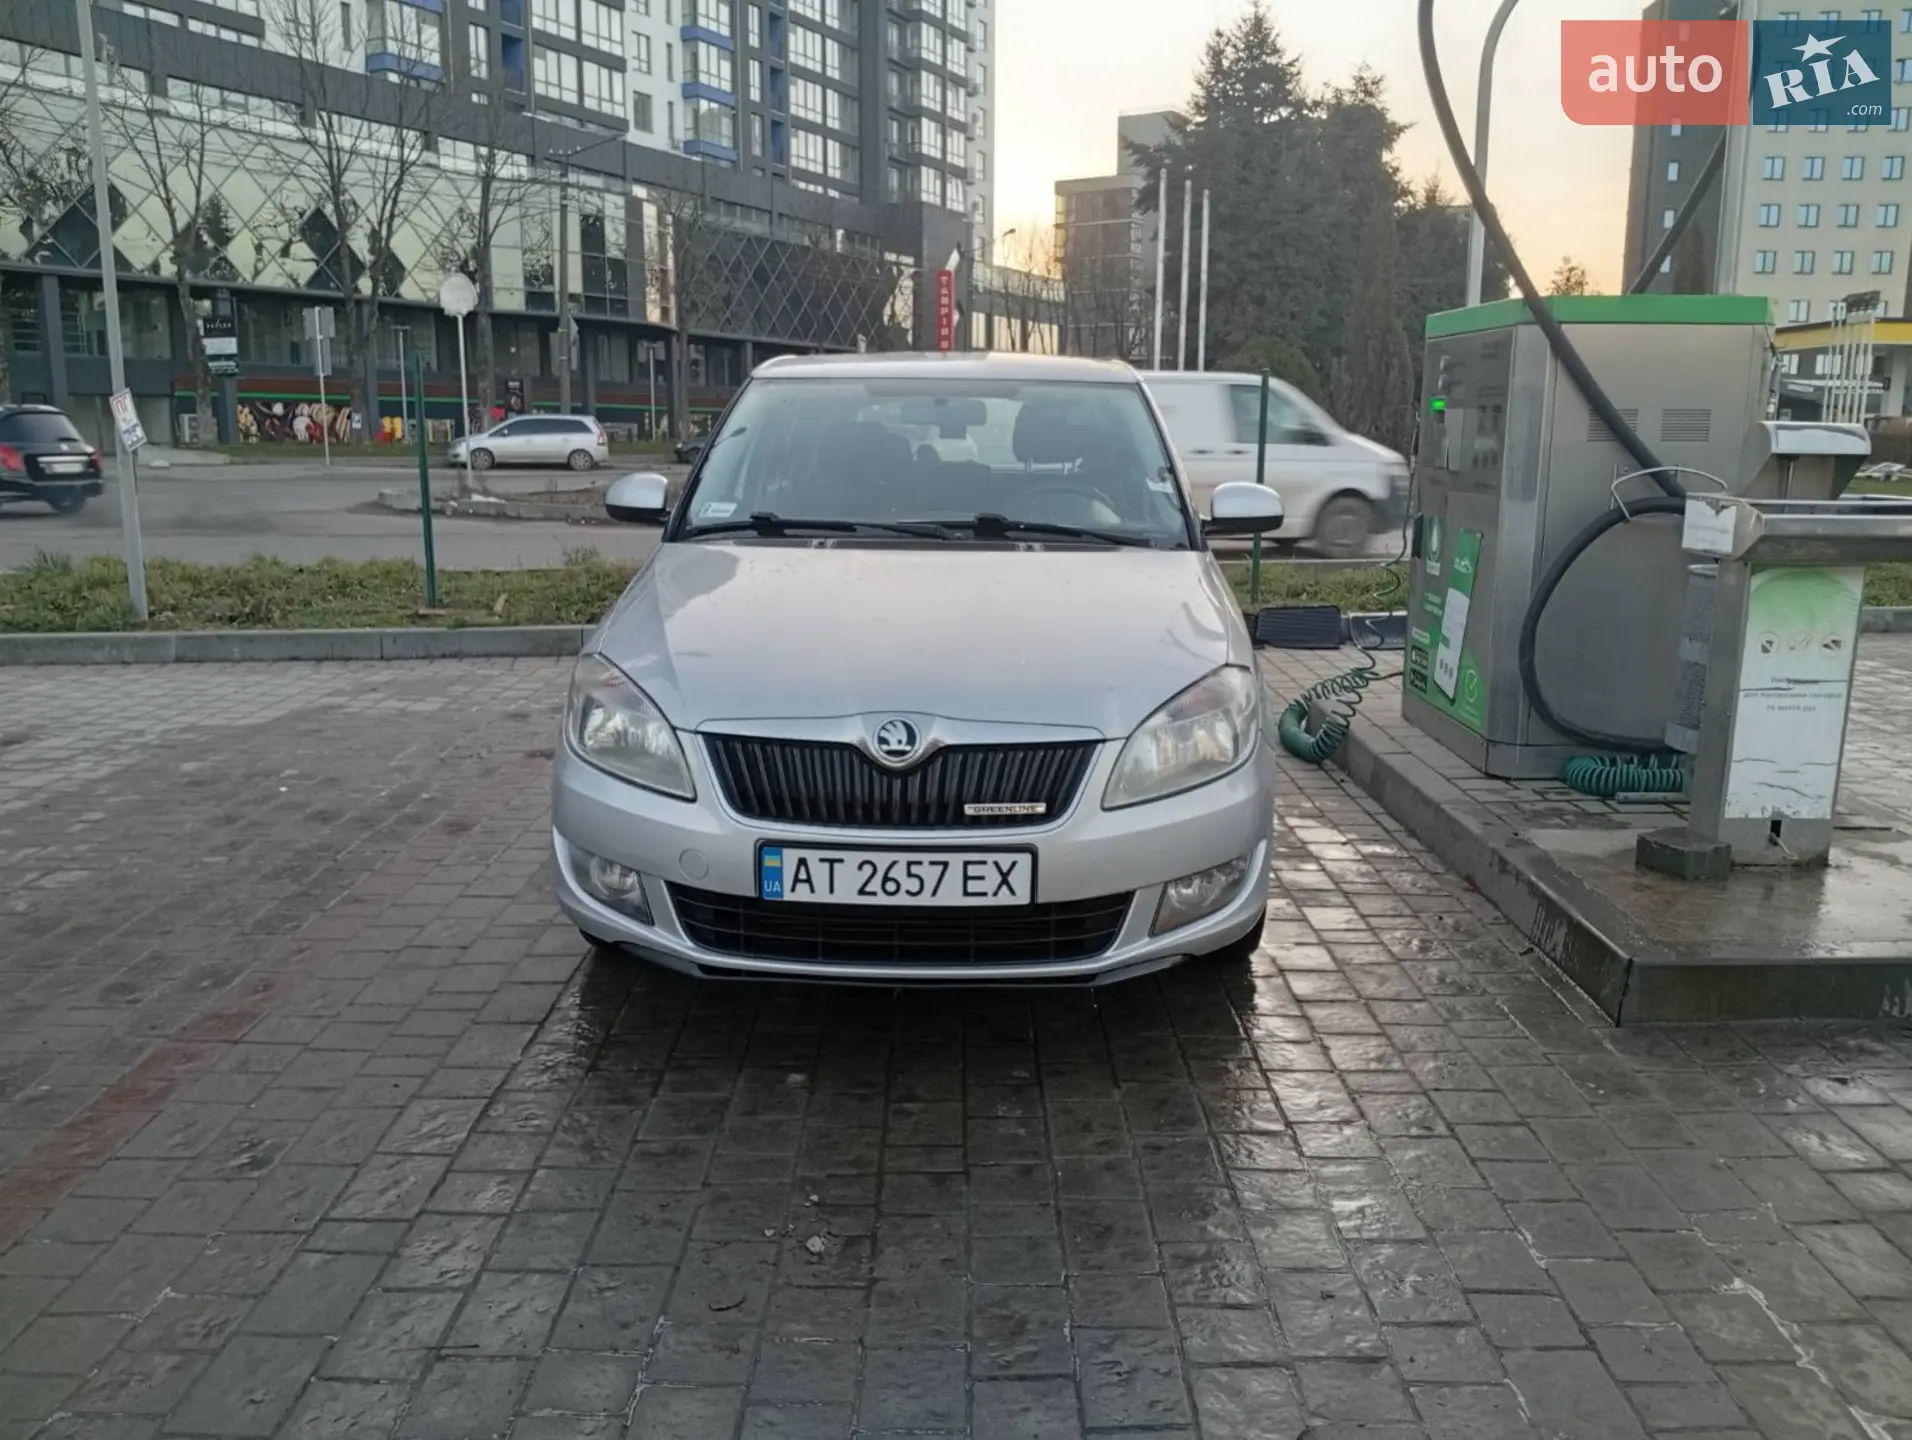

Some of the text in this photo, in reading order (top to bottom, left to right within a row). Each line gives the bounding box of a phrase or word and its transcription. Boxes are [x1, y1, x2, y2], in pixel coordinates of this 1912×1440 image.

[764, 880, 781, 893] UA
[790, 857, 1018, 897] AT 2657 EX
